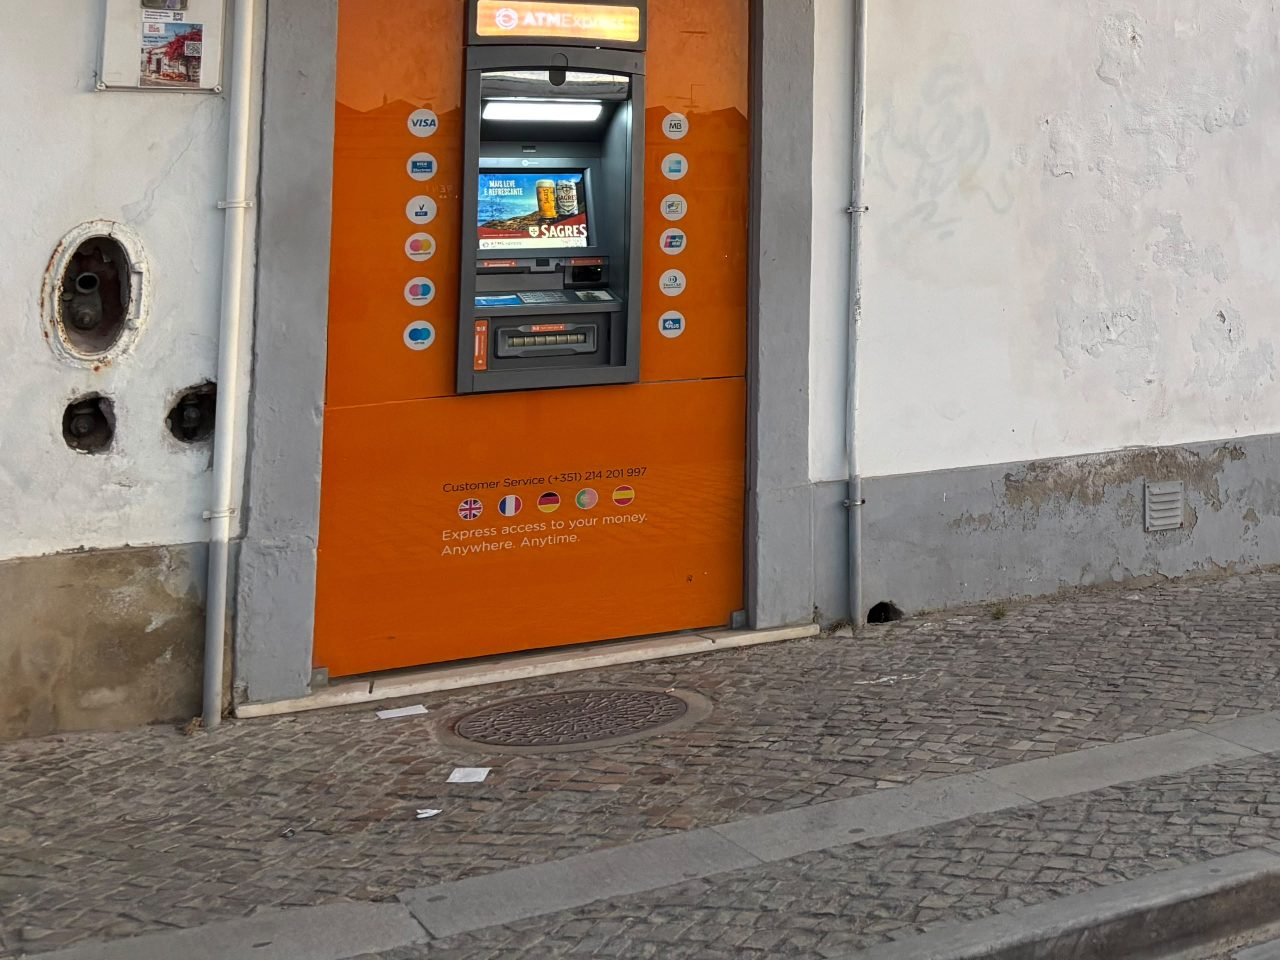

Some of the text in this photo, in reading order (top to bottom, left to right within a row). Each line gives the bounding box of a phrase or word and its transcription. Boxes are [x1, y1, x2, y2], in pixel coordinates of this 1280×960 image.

[411, 118, 437, 128] VISA
[668, 122, 682, 130] MB
[503, 180, 516, 188] LEVE
[541, 223, 588, 238] SAGRES
[442, 467, 647, 493] Customer Service (+351) 214 201 997
[442, 512, 648, 542] Express access to your money.
[441, 534, 580, 557] Anywhere. Anytime.
